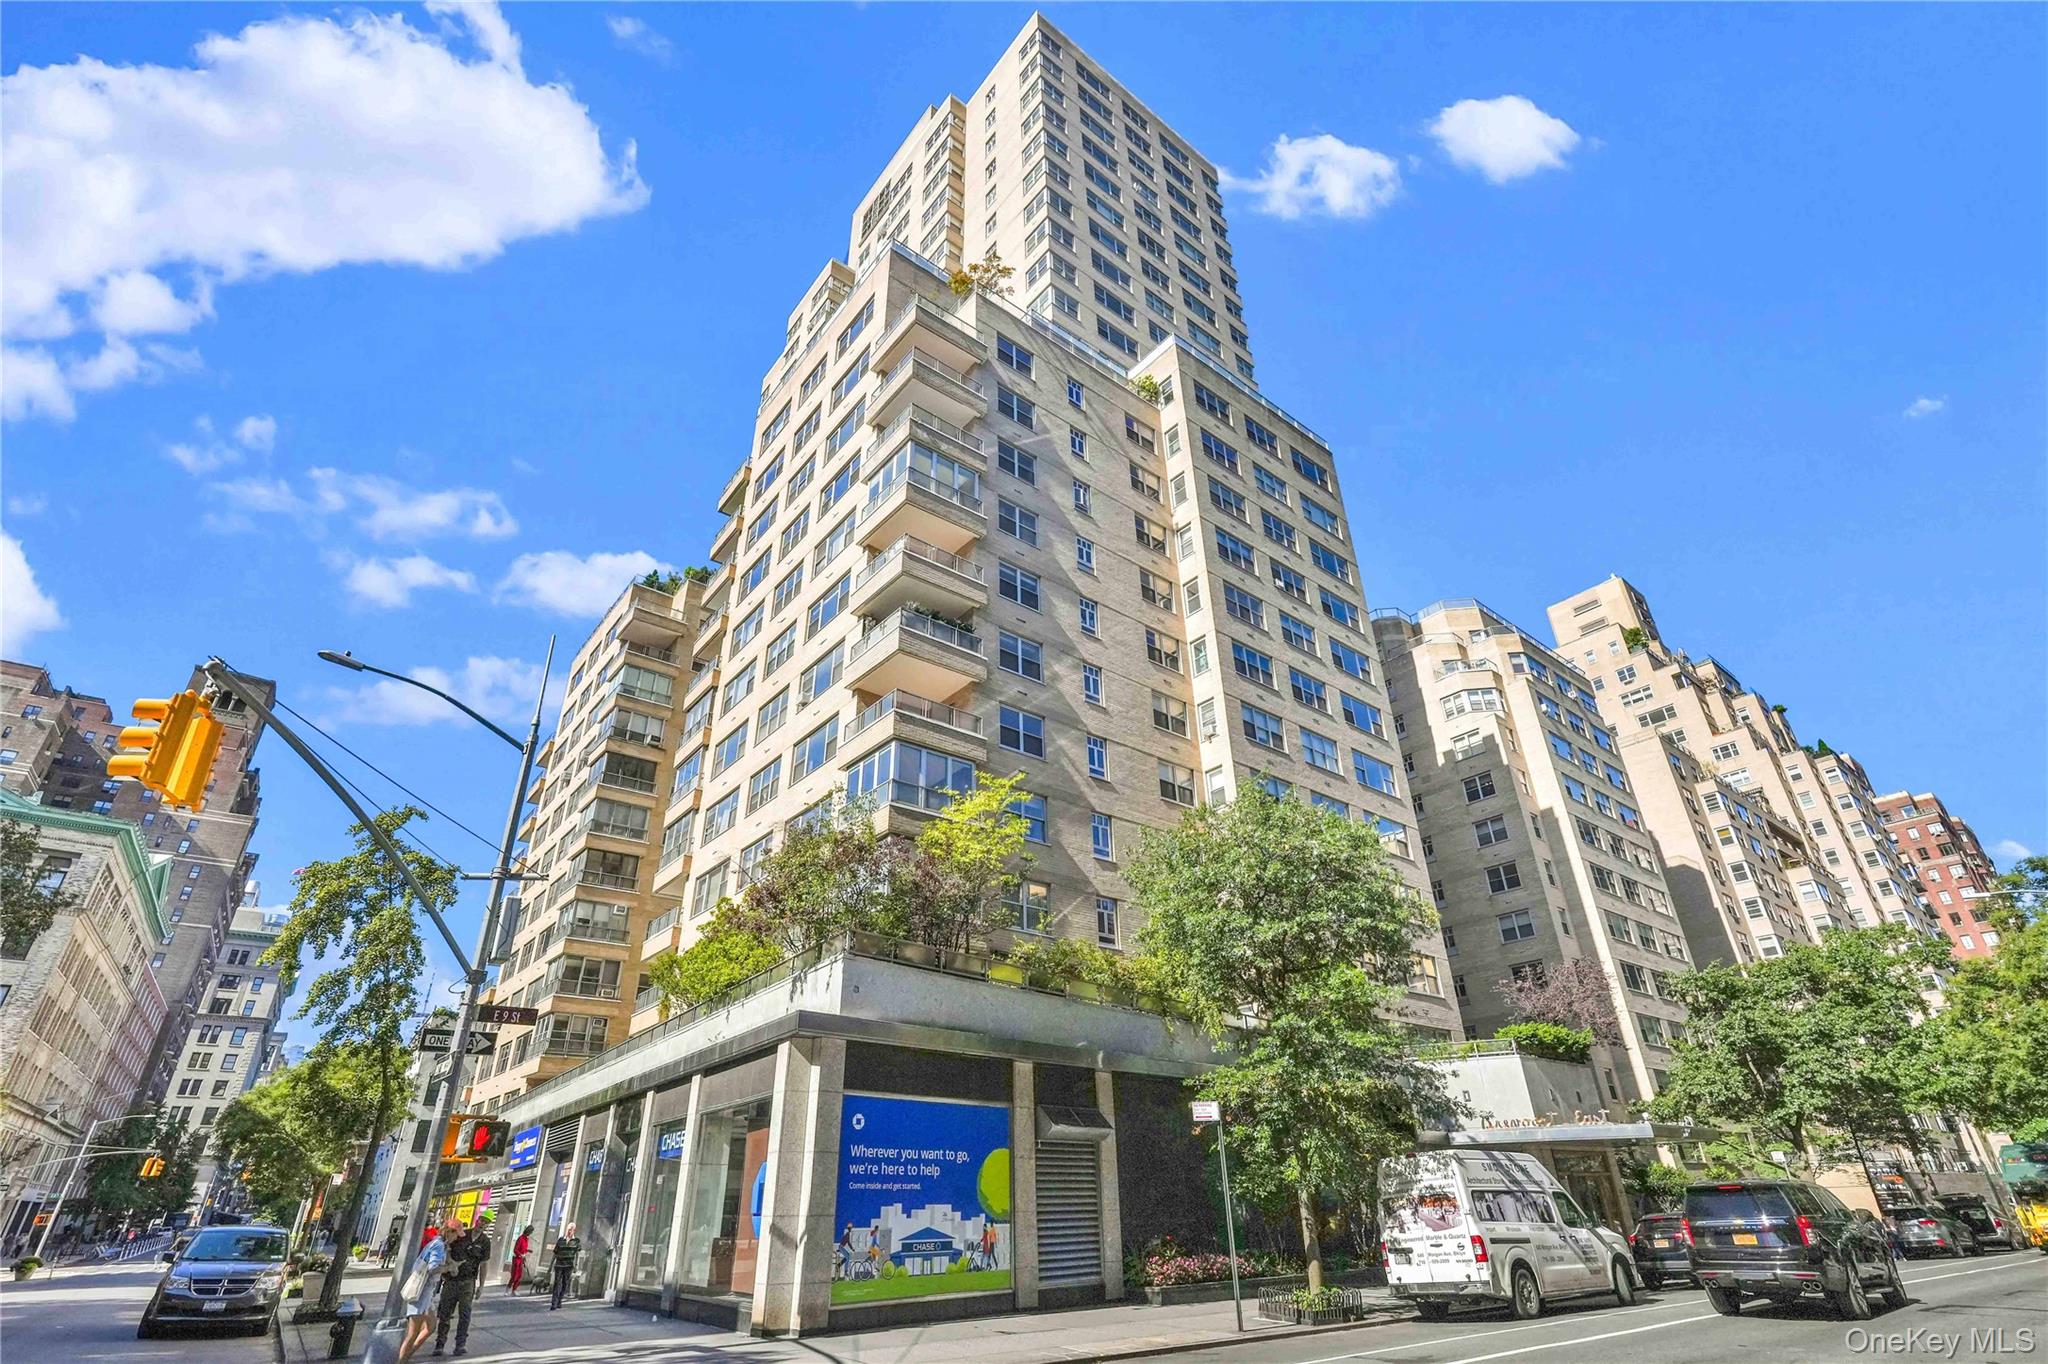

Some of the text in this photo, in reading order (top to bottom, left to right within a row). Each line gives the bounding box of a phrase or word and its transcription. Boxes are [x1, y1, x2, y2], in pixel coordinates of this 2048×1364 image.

[494, 1011, 521, 1023] E 9 St
[429, 1036, 450, 1046] ONE
[662, 1130, 686, 1151] CHASE
[589, 1148, 605, 1164] CHAS
[850, 1144, 970, 1164] Wherever you want to go,
[849, 1162, 940, 1179] we're here to help
[849, 1181, 921, 1191] Come inside and get started.
[1426, 1232, 1442, 1241] Marble
[1448, 1231, 1467, 1240] Quartz
[912, 1242, 936, 1251] CHASE
